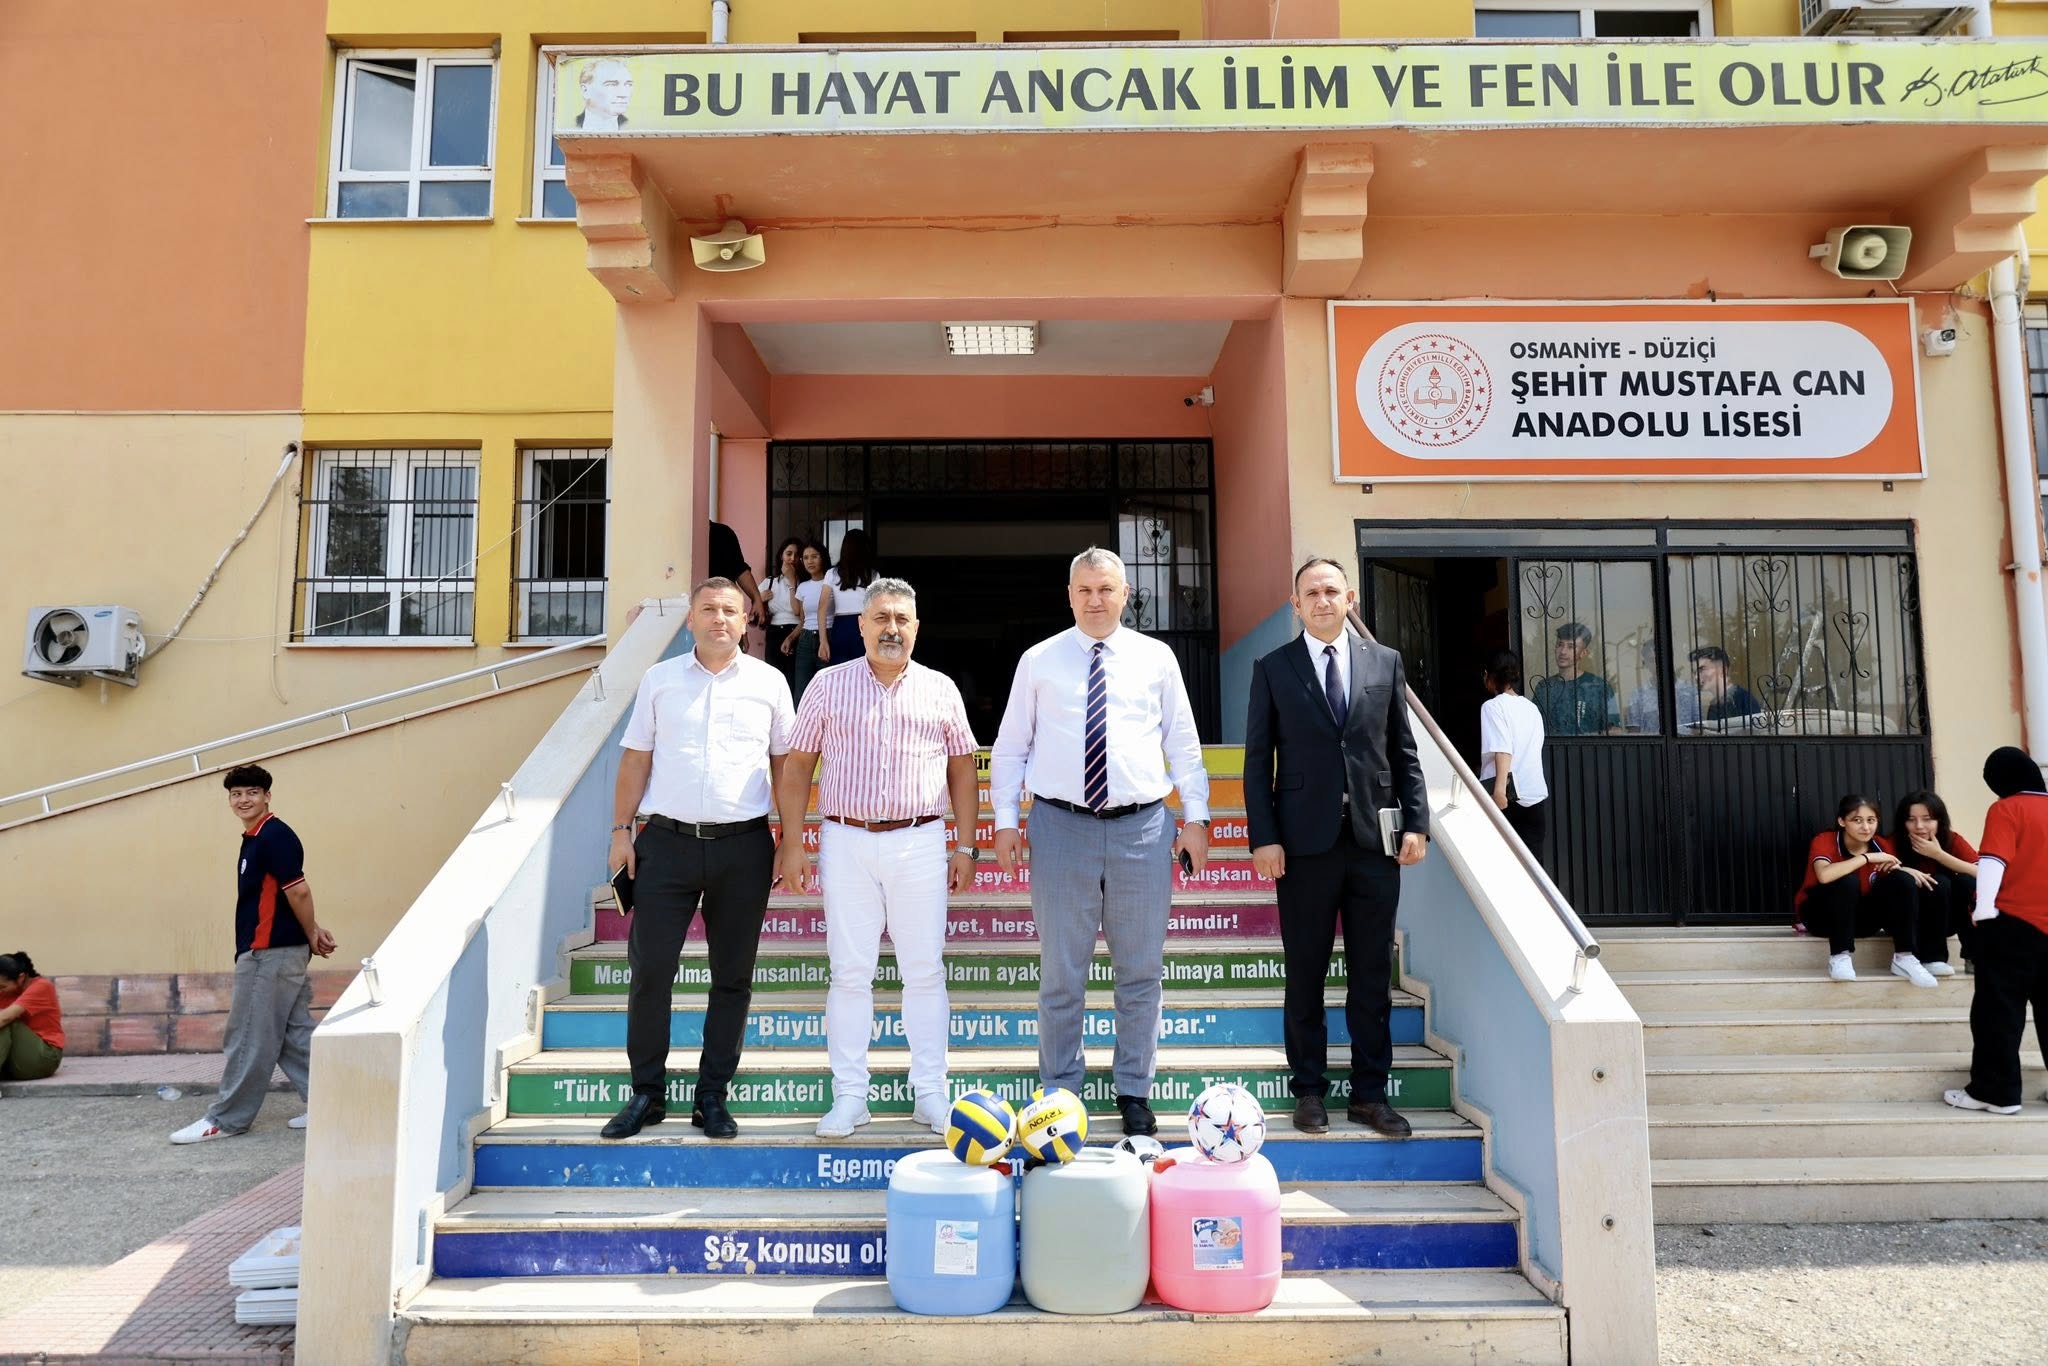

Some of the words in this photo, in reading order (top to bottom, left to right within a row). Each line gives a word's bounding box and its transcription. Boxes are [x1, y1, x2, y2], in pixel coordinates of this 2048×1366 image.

[663, 73, 744, 117] BU
[770, 70, 961, 116] HAYAT
[981, 67, 1201, 113] ANCAK
[1223, 55, 1349, 110] İLİM
[1372, 64, 1441, 108] VE
[1469, 62, 1579, 108] FEN
[1607, 51, 1695, 107] İLE
[1719, 61, 1886, 107] OLUR
[1510, 340, 1622, 360] OSMANİYE
[1644, 335, 1717, 363] DÜZİÇİ
[1511, 363, 1608, 405] ŞEHİT
[1621, 370, 1783, 397] MUSTAFA
[1792, 369, 1866, 396] CAN
[1511, 410, 1688, 438] ANADOLU
[1703, 403, 1803, 438] LİSESİ
[1167, 914, 1239, 931] aimdir!
[1162, 960, 1225, 983] almaya
[950, 1015, 1009, 1041] üyük
[554, 1079, 611, 1102] "Türk
[726, 1079, 824, 1102] karakteri
[1029, 1108, 1063, 1130] TRYON
[704, 1235, 749, 1263] Söz
[757, 1237, 850, 1264] konusu
